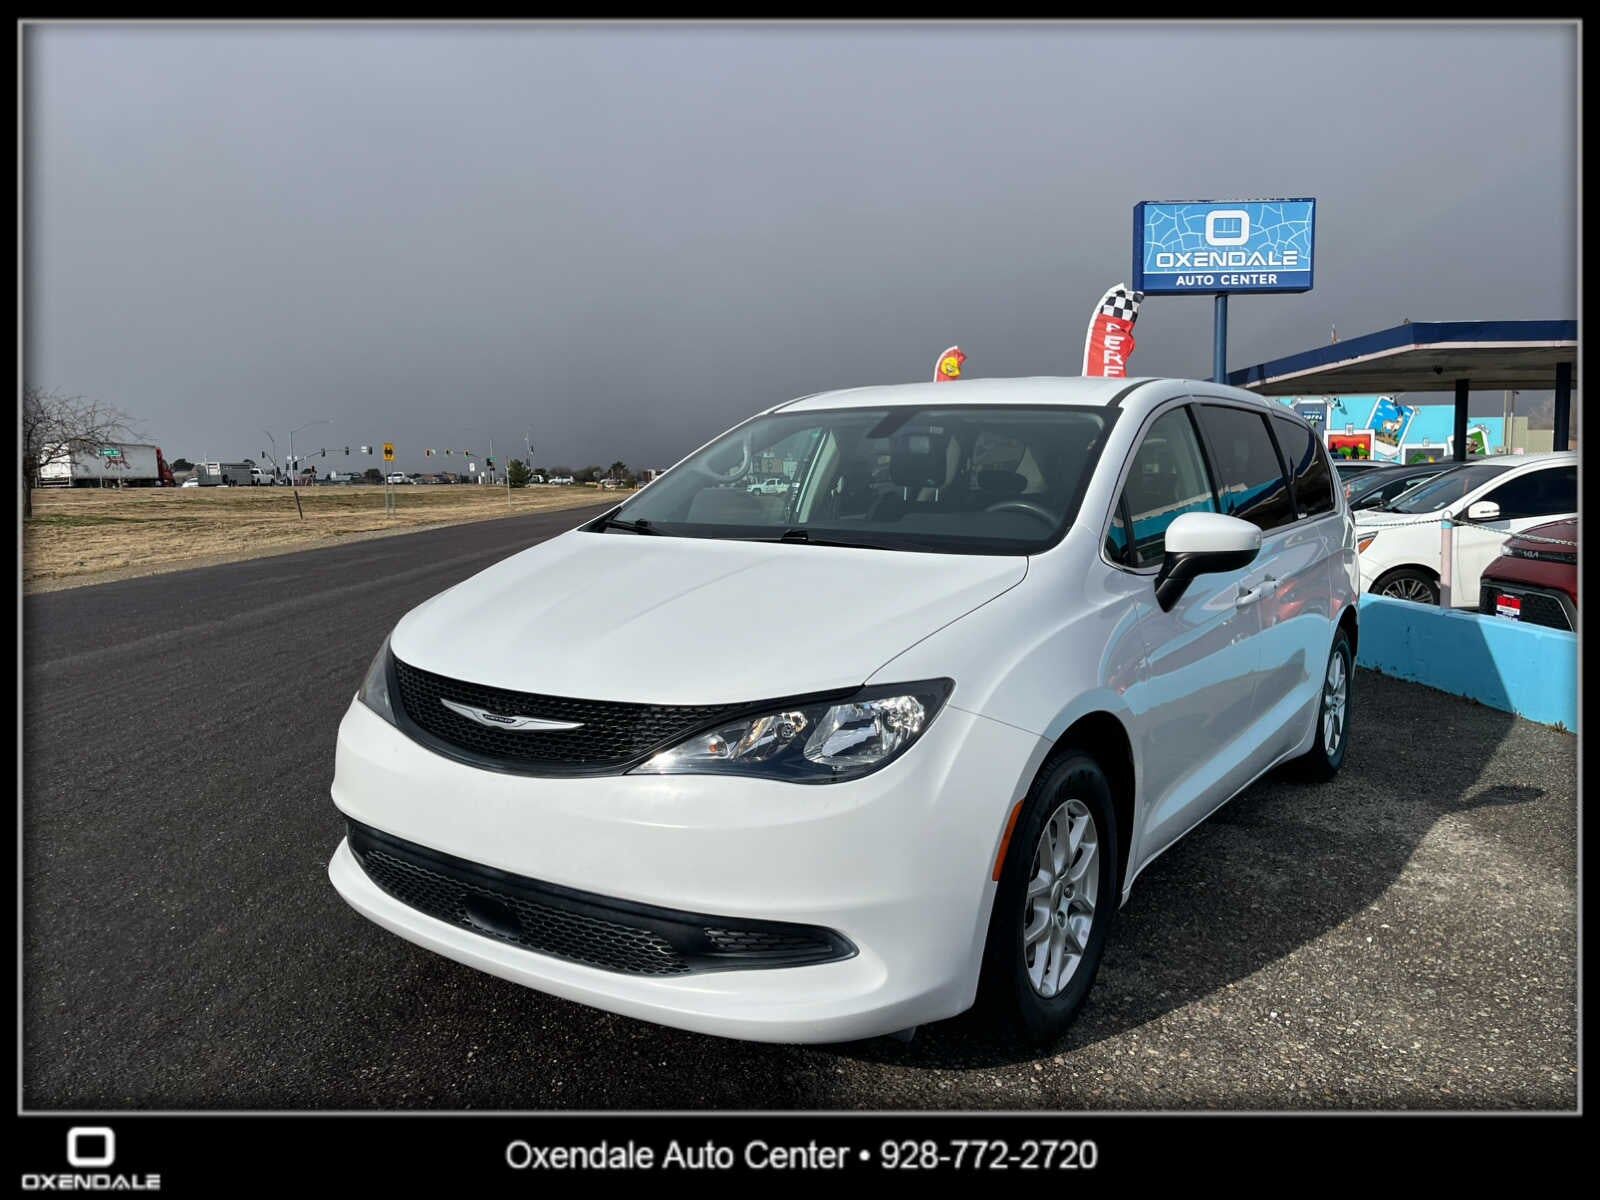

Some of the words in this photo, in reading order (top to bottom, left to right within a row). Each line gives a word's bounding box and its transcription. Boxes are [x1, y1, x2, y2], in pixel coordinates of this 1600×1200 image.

[1156, 250, 1298, 268] OXENDALE
[1176, 275, 1214, 286] AUTO
[1220, 274, 1278, 285] CENTER
